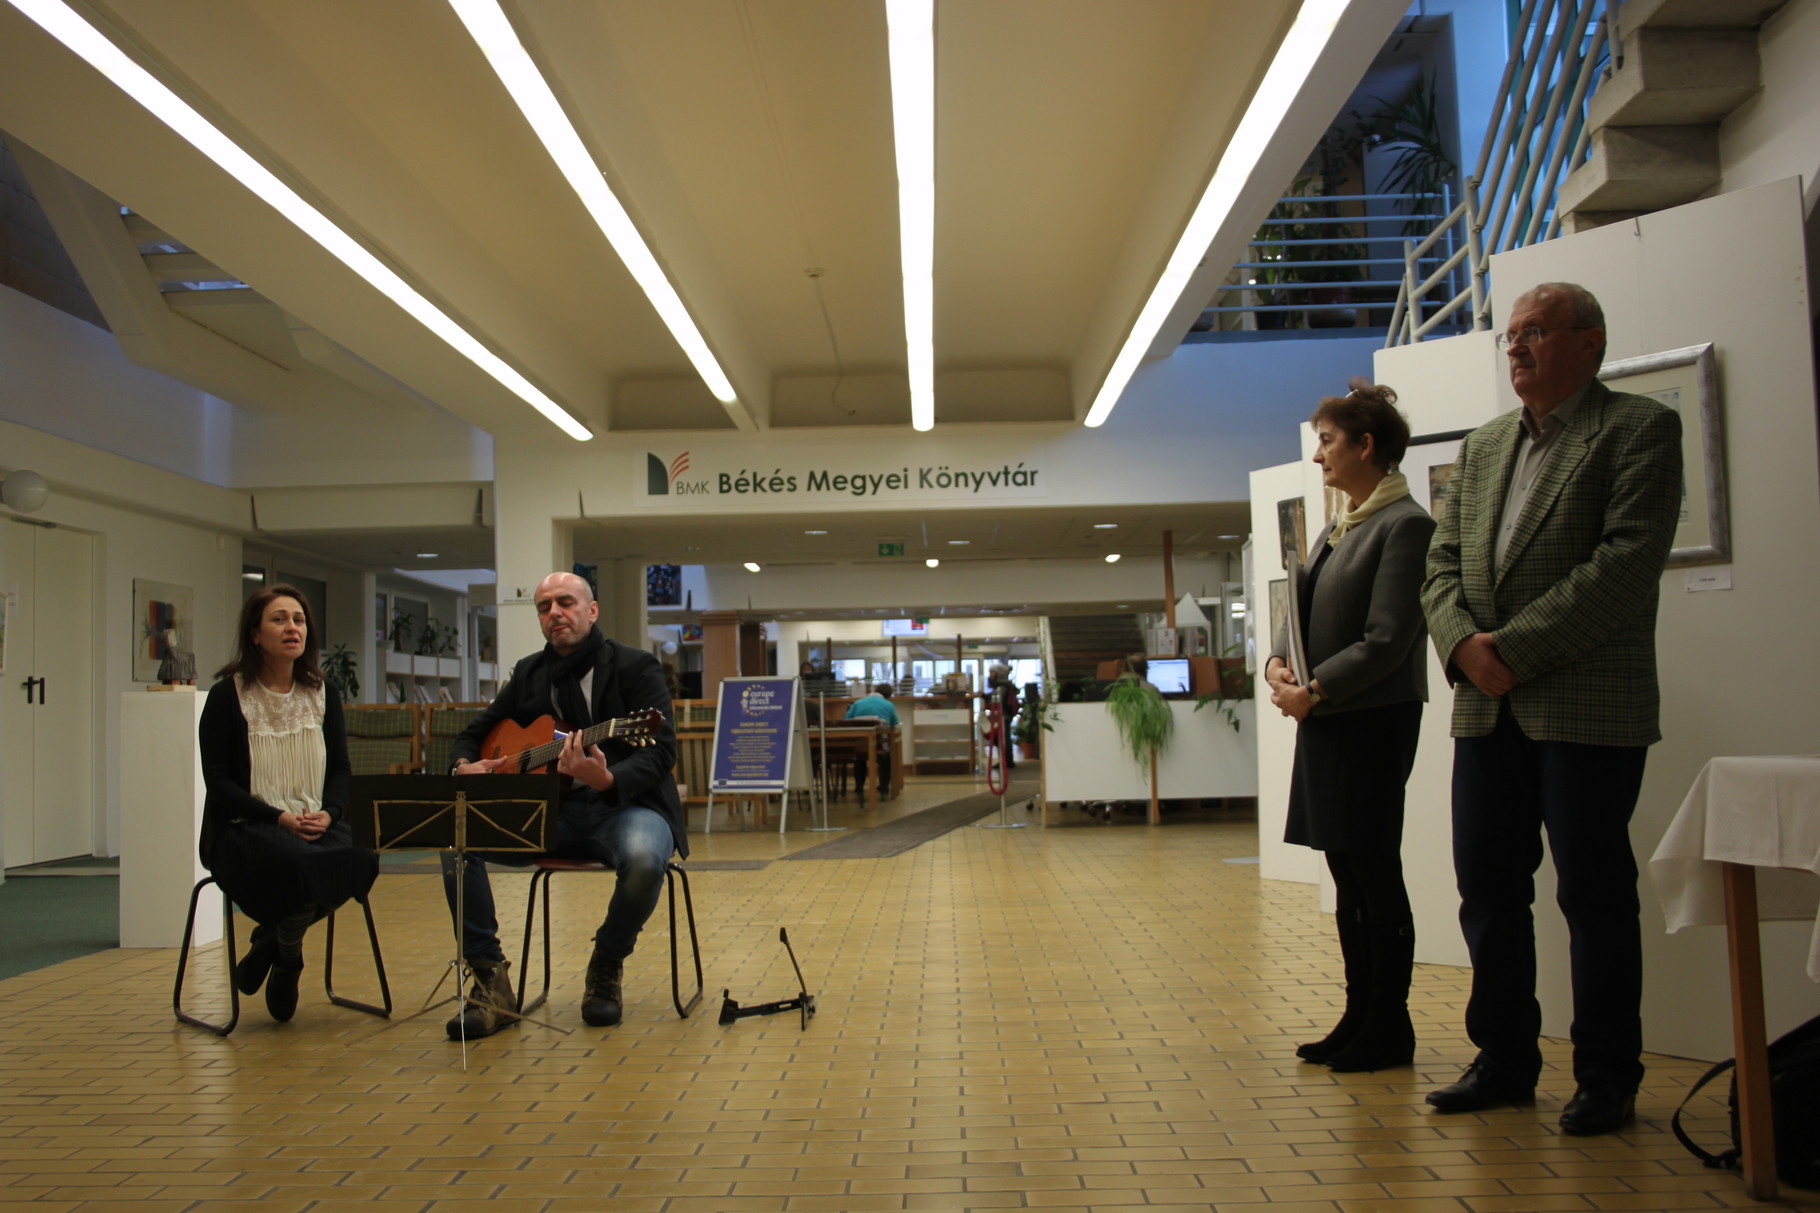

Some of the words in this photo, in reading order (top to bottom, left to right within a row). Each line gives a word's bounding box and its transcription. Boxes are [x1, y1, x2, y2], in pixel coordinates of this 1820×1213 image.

[719, 468, 798, 494] Békés
[806, 467, 909, 496] Megyei
[919, 462, 1039, 493] Könyvtár
[676, 481, 710, 494] BMK
[750, 690, 775, 698] europe
[749, 697, 770, 705] direct
